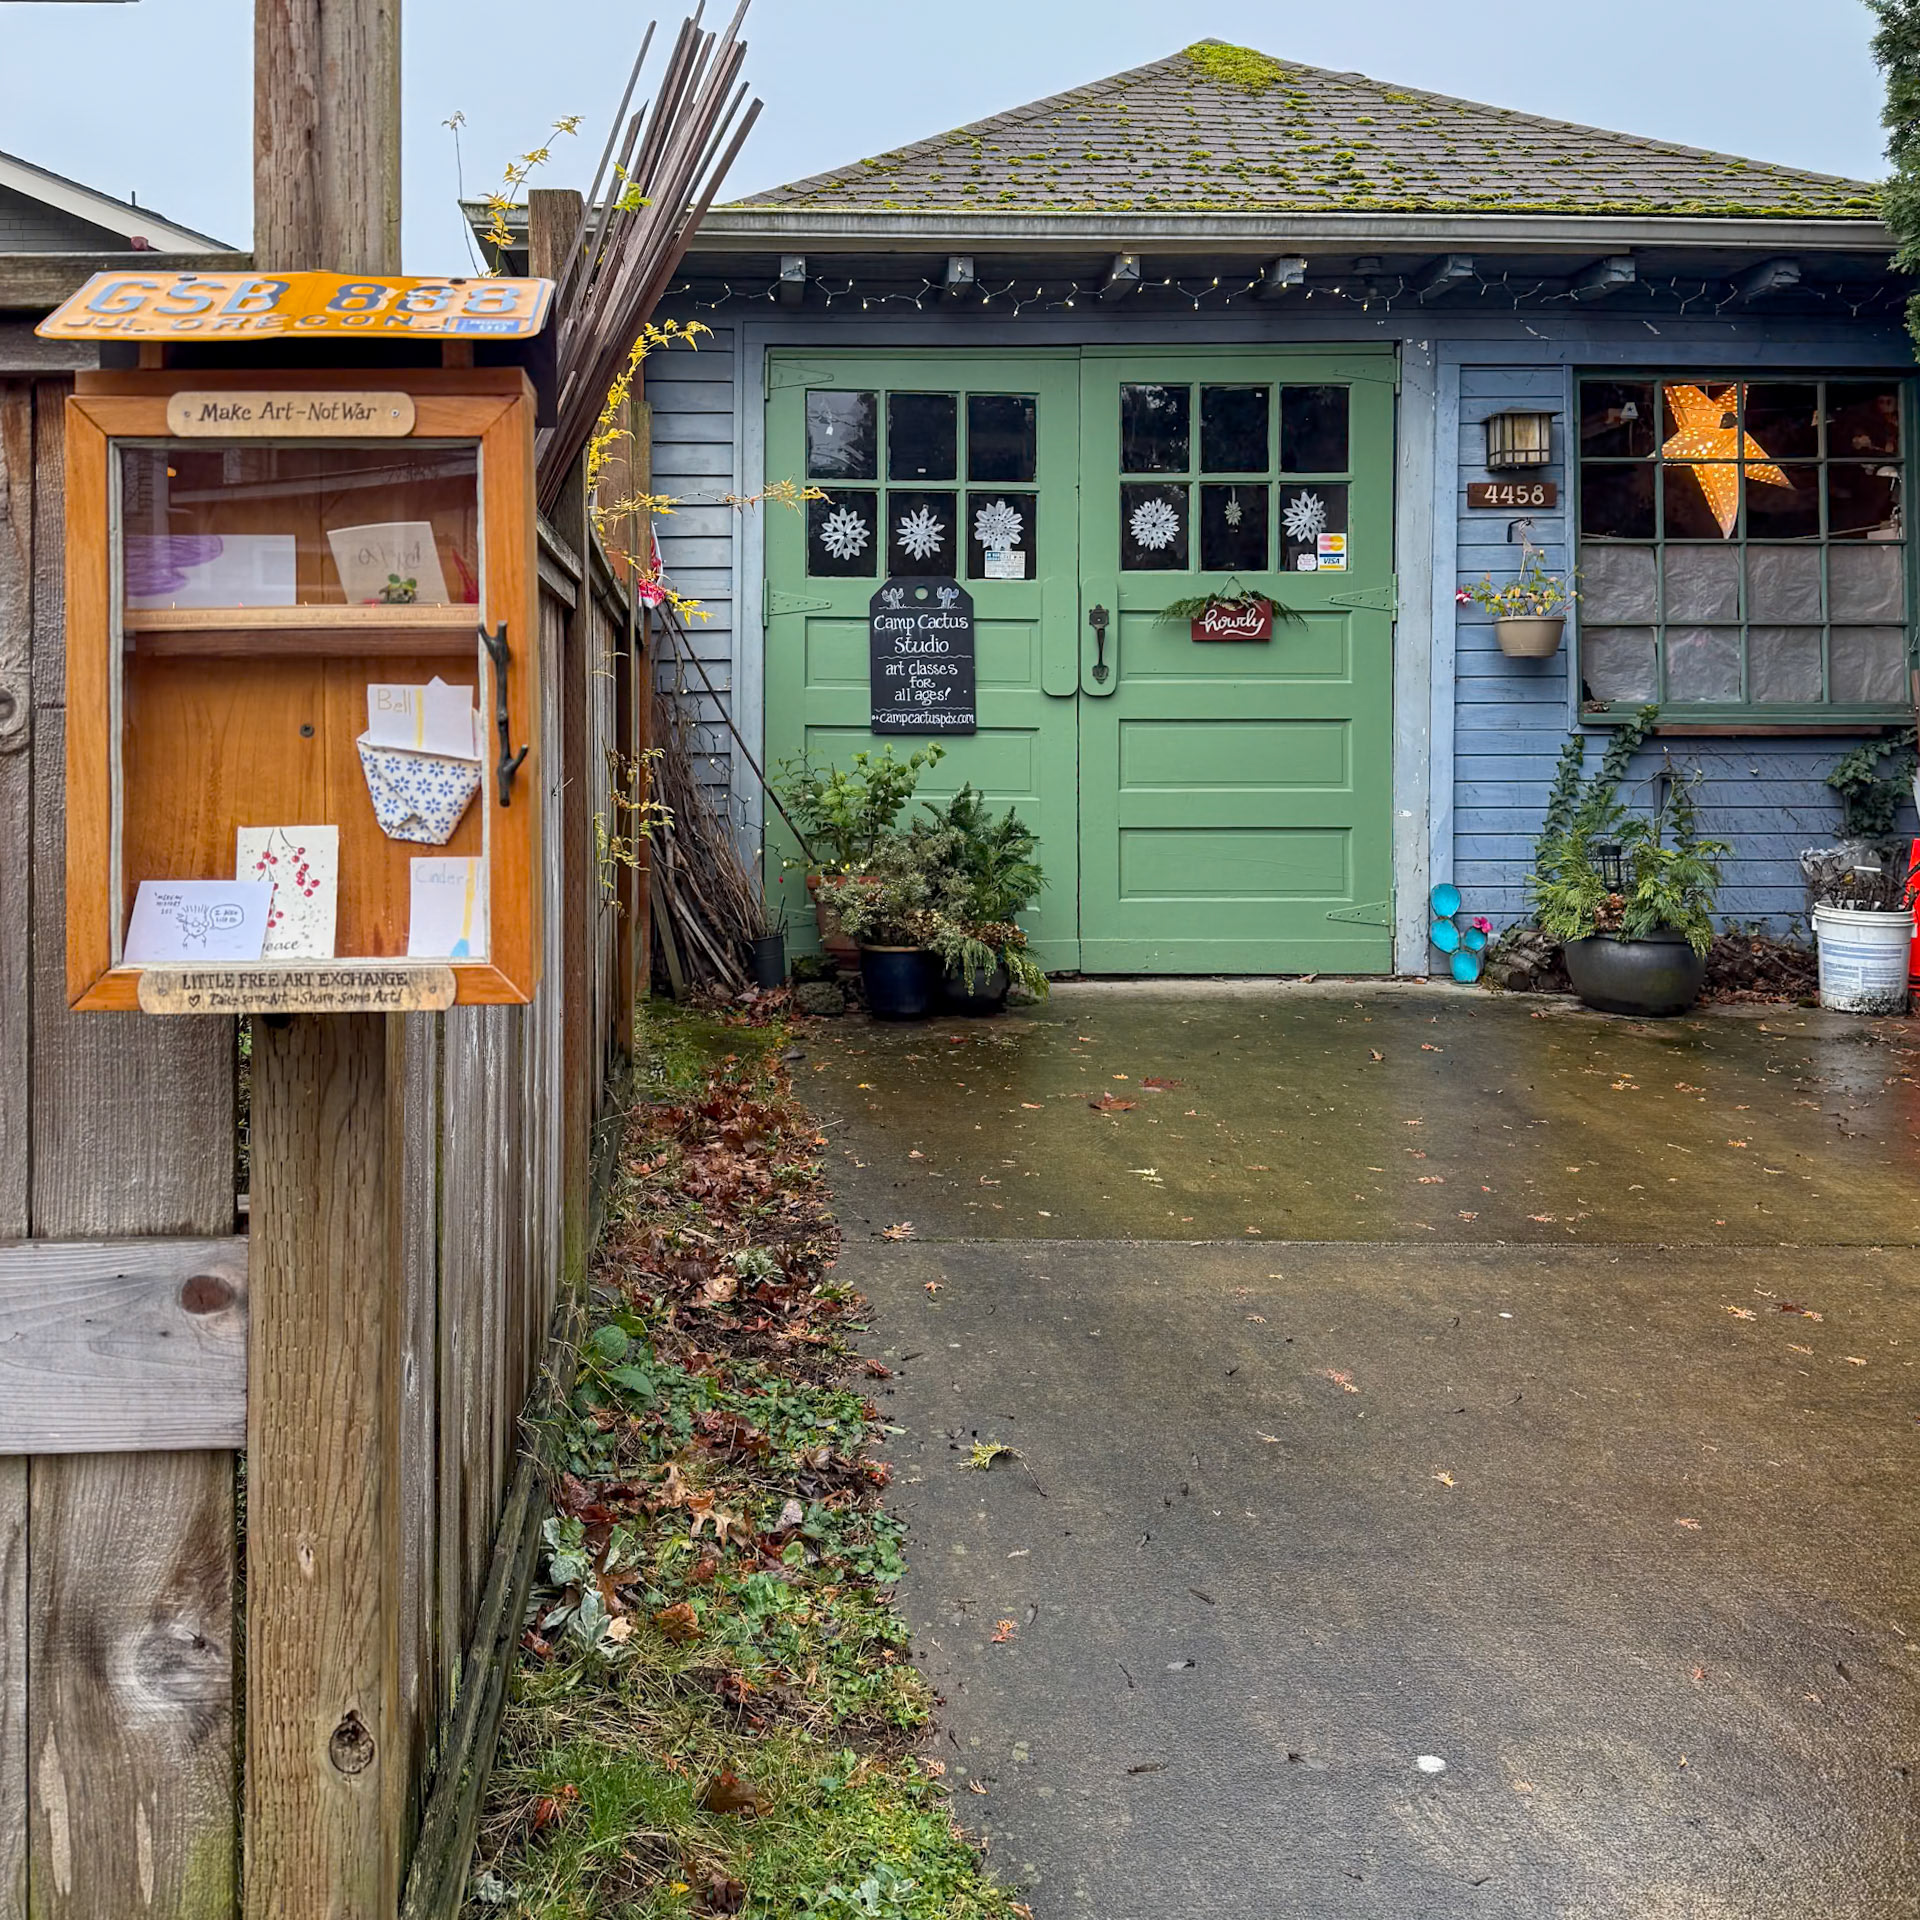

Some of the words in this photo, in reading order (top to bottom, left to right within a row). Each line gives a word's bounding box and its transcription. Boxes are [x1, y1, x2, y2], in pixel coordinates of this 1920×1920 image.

[85, 280, 290, 315] GSB
[170, 314, 415, 332] OREGON
[198, 403, 251, 422] Make
[342, 402, 377, 421] War
[1484, 484, 1545, 505] 4458
[1323, 557, 1340, 565] VISA
[873, 614, 915, 637] Camp
[917, 612, 969, 629] Cactus
[1198, 608, 1265, 636] howdy
[894, 634, 949, 654] Studio
[885, 661, 905, 676] art
[908, 660, 958, 676] classes
[377, 688, 412, 716] Bell
[894, 688, 911, 701] all
[914, 687, 952, 706] ages!
[879, 711, 975, 728] campcactuspdx.com
[262, 940, 301, 952] eace
[182, 973, 235, 990] LITTLE
[238, 972, 279, 989] FREE
[282, 972, 314, 987] ART
[316, 972, 408, 987] EXCHANGE
[373, 988, 403, 1003] Art!
